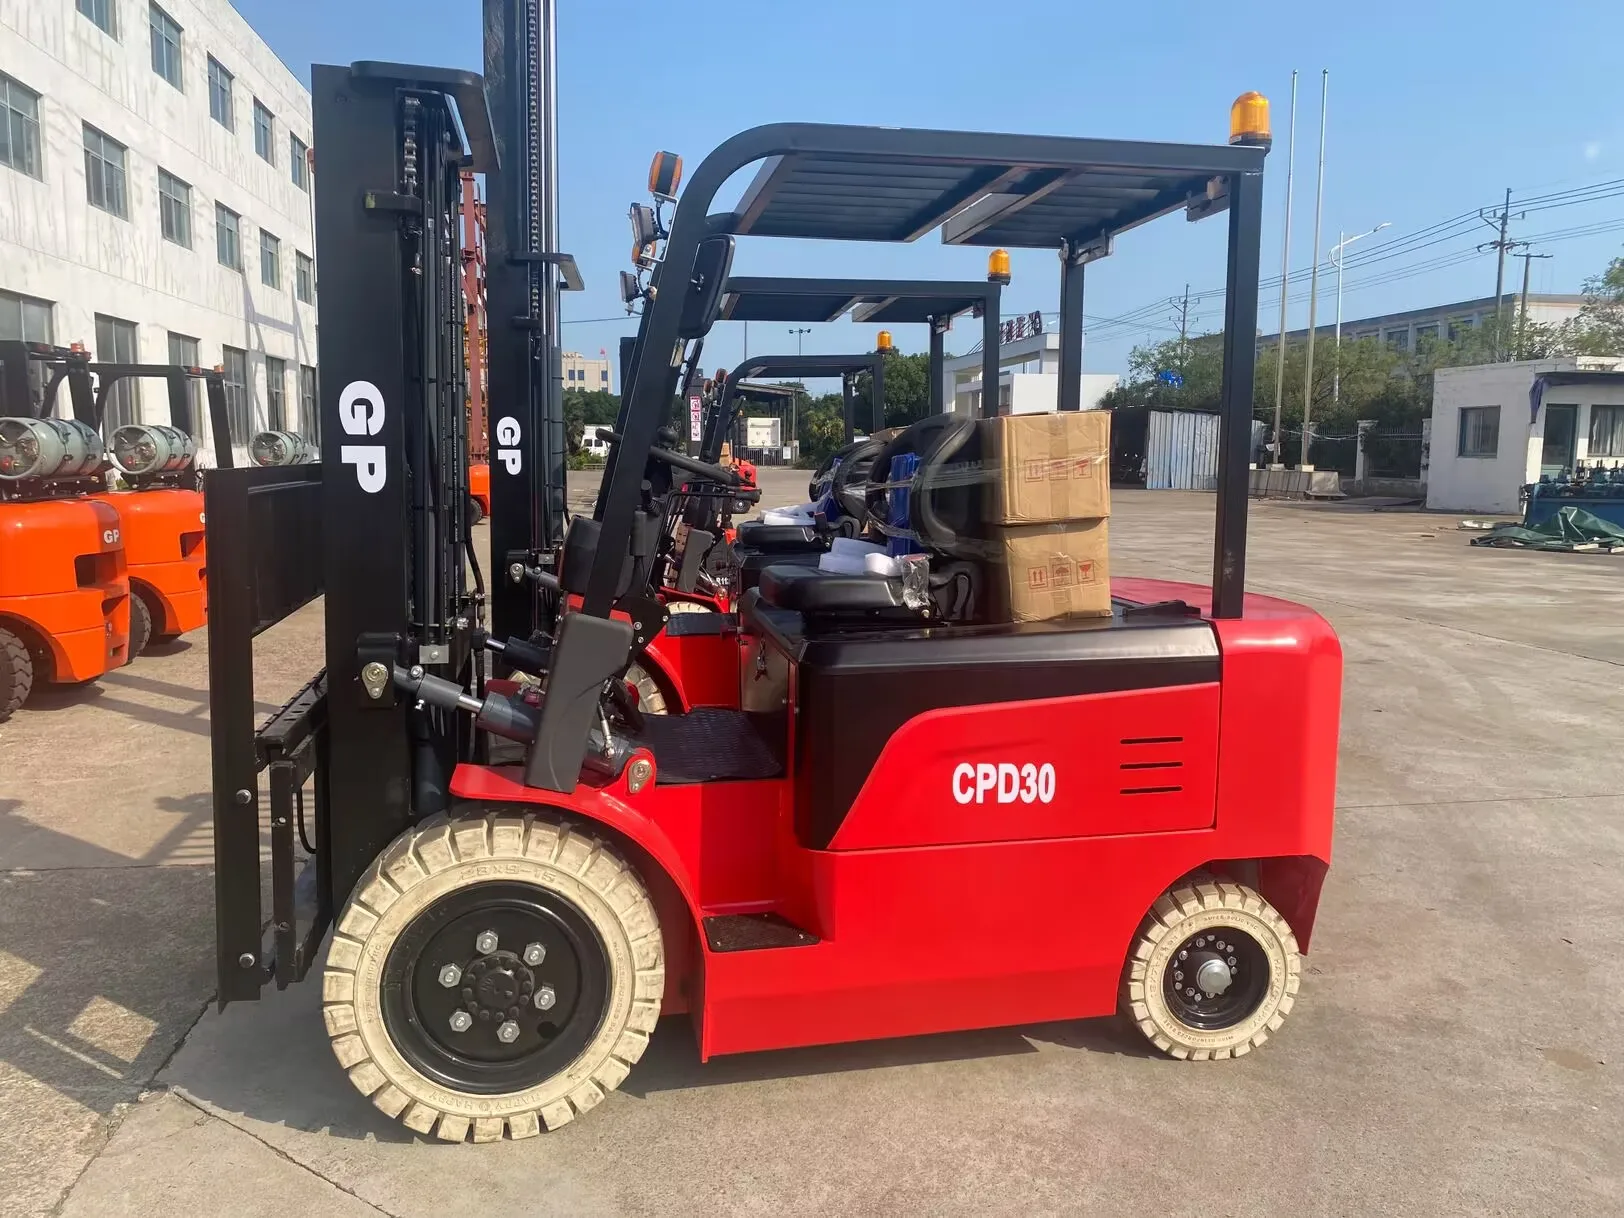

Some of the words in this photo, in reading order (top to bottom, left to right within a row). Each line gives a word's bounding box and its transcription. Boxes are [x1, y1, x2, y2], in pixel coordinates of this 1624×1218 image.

[339, 380, 387, 493] GP
[496, 416, 522, 475] GP
[103, 529, 120, 544] GP
[952, 762, 1056, 805] CPD30
